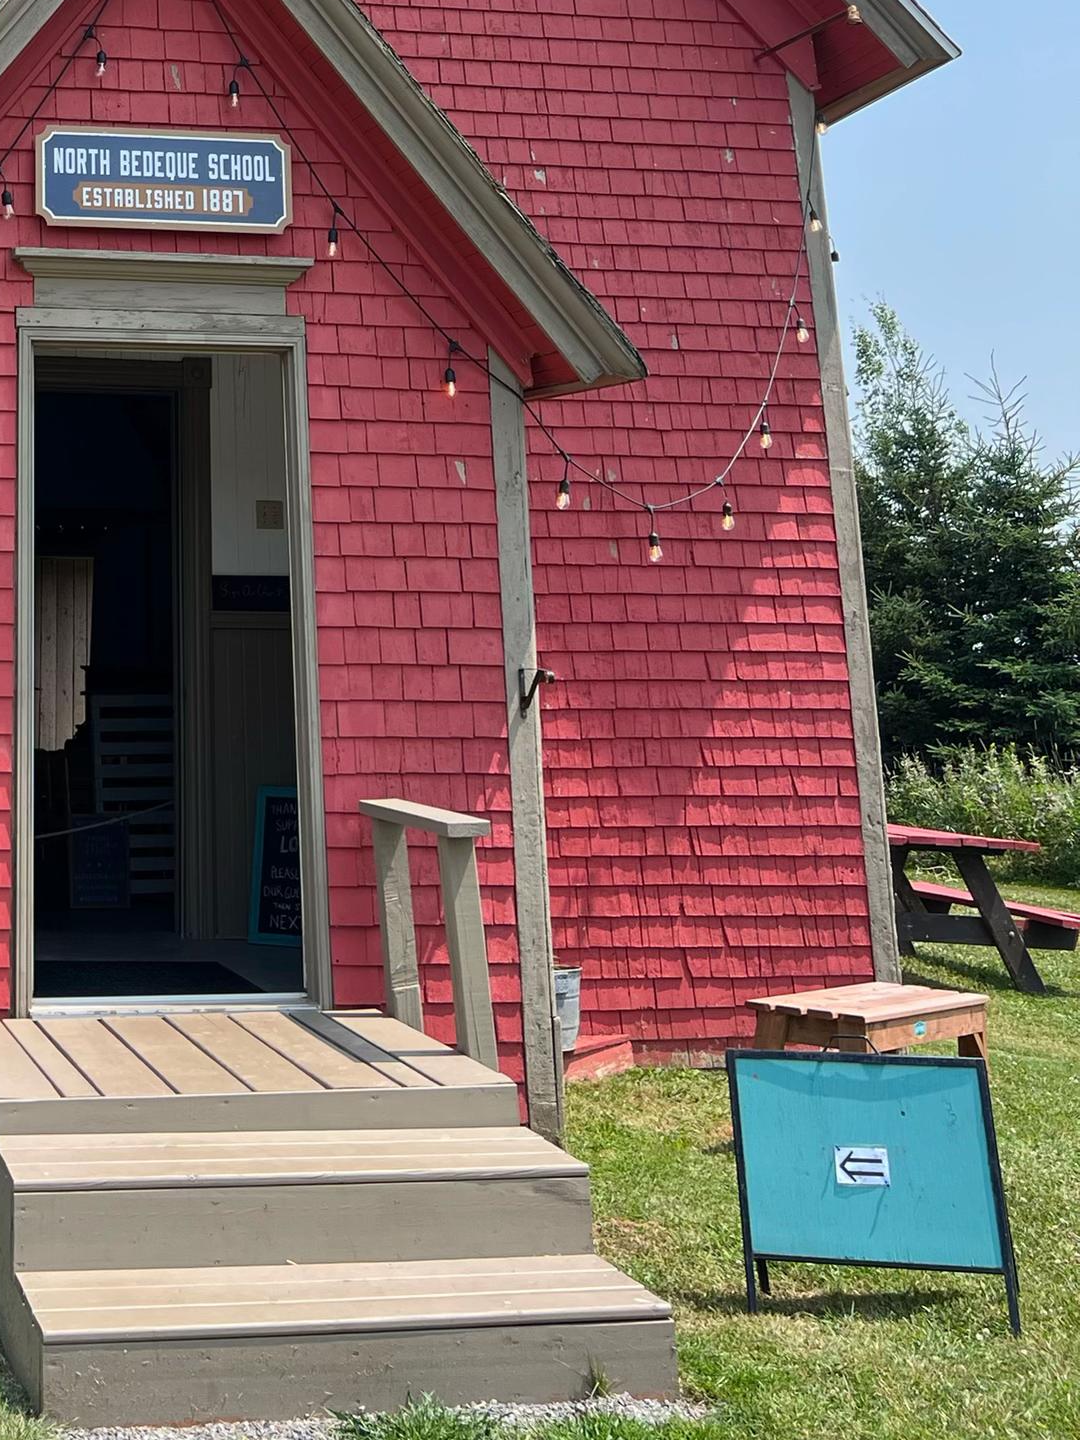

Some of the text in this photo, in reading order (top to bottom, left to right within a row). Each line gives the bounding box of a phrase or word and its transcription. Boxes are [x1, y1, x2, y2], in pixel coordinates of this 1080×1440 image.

[53, 148, 276, 182] NORTH BEDEQUE SCHOOL
[82, 187, 244, 213] ESTABLISHED 1887
